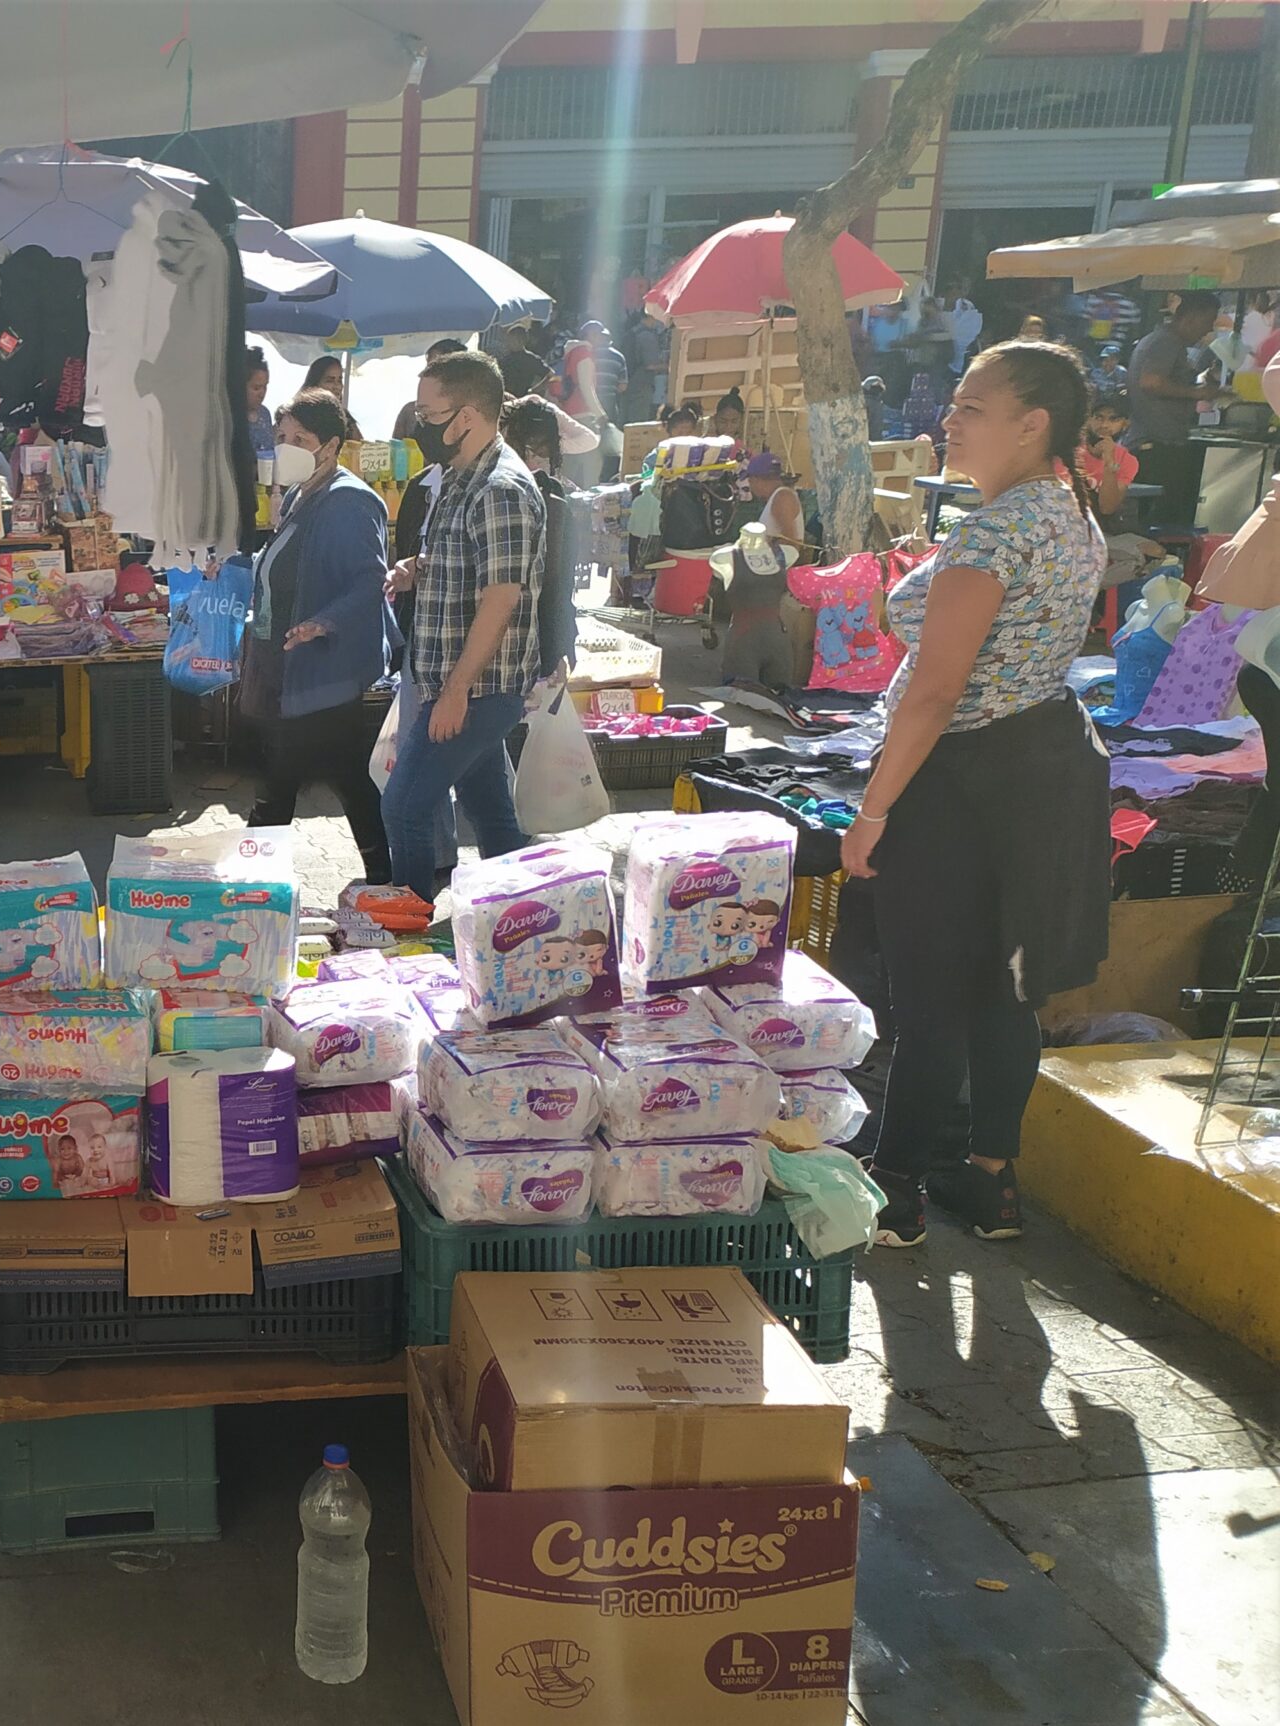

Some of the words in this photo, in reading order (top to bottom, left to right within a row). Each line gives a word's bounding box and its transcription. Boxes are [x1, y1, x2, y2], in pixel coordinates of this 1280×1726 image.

[241, 841, 256, 852] 20
[673, 871, 744, 894] Davey
[130, 889, 191, 909] Hugme
[495, 907, 558, 936] Davey
[739, 940, 749, 951] G
[573, 972, 582, 982] G
[28, 1026, 88, 1044] Hugme
[749, 1026, 805, 1047] Davey
[314, 1030, 361, 1053] Davey
[3, 1068, 18, 1078] 20
[0, 1179, 10, 1190] G
[521, 1185, 580, 1202] Davey
[274, 1229, 315, 1243] COAMO
[669, 1338, 708, 1347] SIZE:
[713, 1339, 748, 1348] CTN
[666, 1347, 697, 1356] NO:
[701, 1348, 754, 1357] BATCH
[674, 1356, 721, 1365] DATE:
[616, 1384, 722, 1395] Packs/Carton
[726, 1385, 746, 1395] 24
[777, 1507, 828, 1522] 24x8
[532, 1516, 787, 1578] Cuddsies
[600, 1583, 739, 1617] Premium
[732, 1638, 756, 1665] L
[805, 1634, 830, 1660] 8
[720, 1665, 764, 1677] LARGE
[789, 1660, 846, 1672] DIAPERS
[721, 1676, 761, 1686] GRANDE
[797, 1672, 837, 1684] Pañales
[756, 1692, 783, 1702] 10-14
